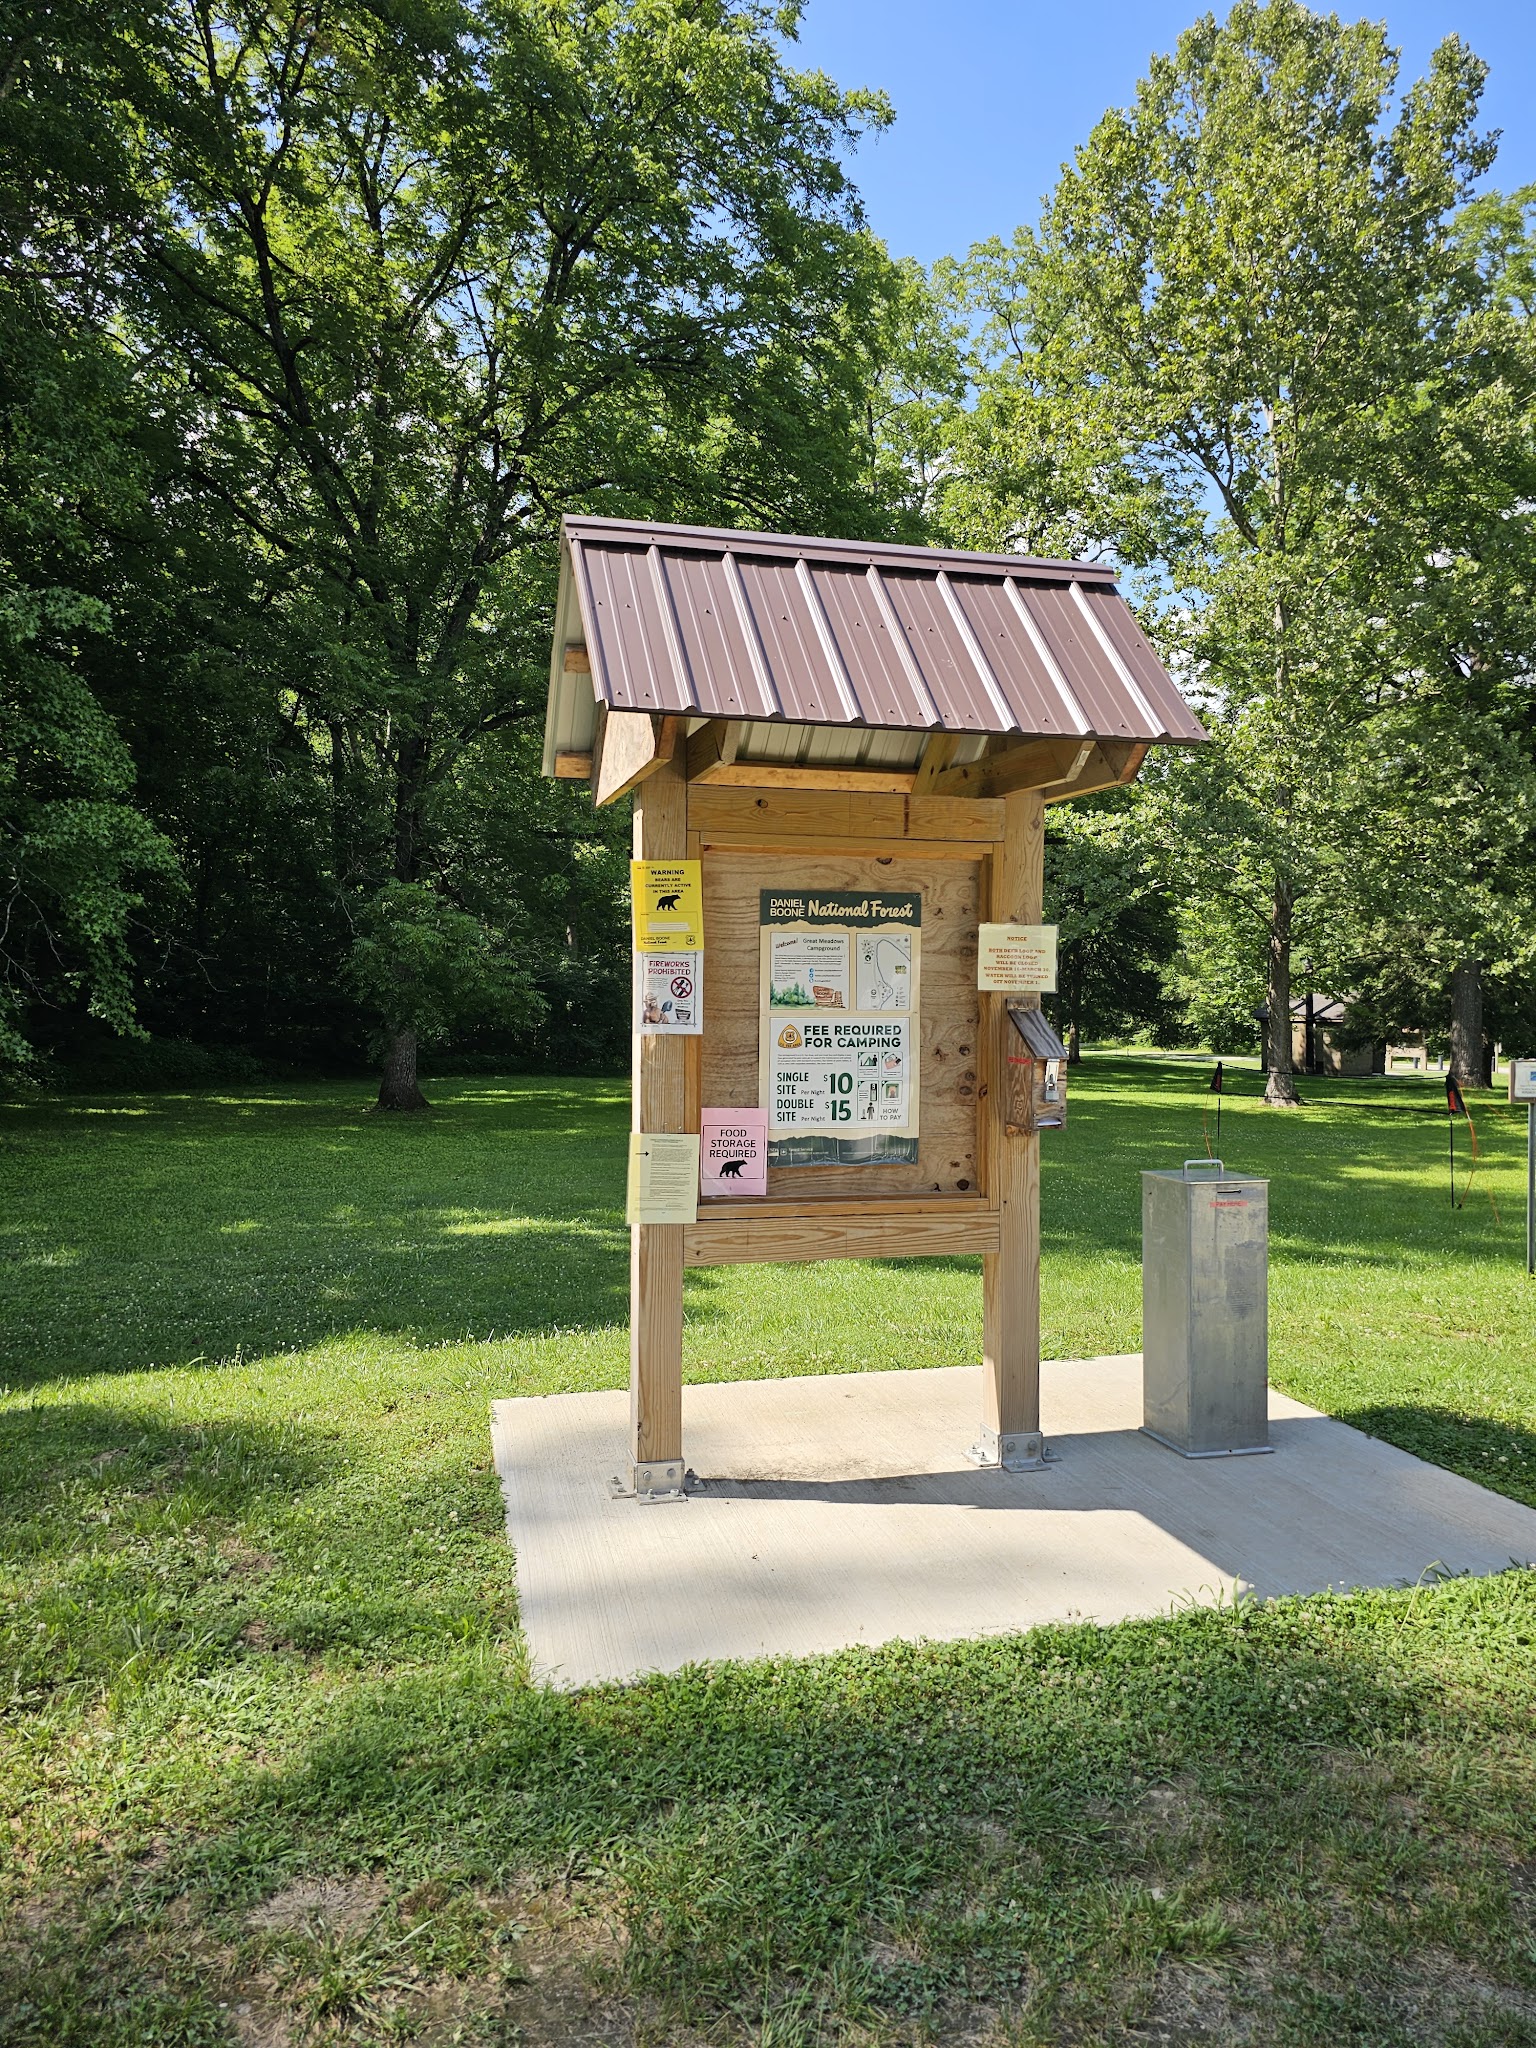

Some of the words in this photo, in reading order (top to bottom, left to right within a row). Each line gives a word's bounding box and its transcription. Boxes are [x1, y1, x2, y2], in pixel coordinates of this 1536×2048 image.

[770, 898, 805, 908] DANIEL
[808, 899, 869, 917] National
[870, 900, 913, 918] Forest
[770, 908, 805, 917] BOONE
[775, 938, 798, 949] Welcome!
[804, 1025, 829, 1036] FEE
[835, 1025, 902, 1036] REQUIRED
[805, 1038, 833, 1048] FOR
[837, 1037, 901, 1048] CAMPING
[777, 1072, 809, 1082] SINGLE
[824, 1072, 853, 1094] $10
[777, 1085, 796, 1095] SITE
[776, 1099, 814, 1109] DOUBLE
[825, 1100, 852, 1121] $15
[777, 1111, 796, 1122] SITE
[720, 1129, 747, 1137] FOOD
[710, 1150, 756, 1158] REQUIRED
